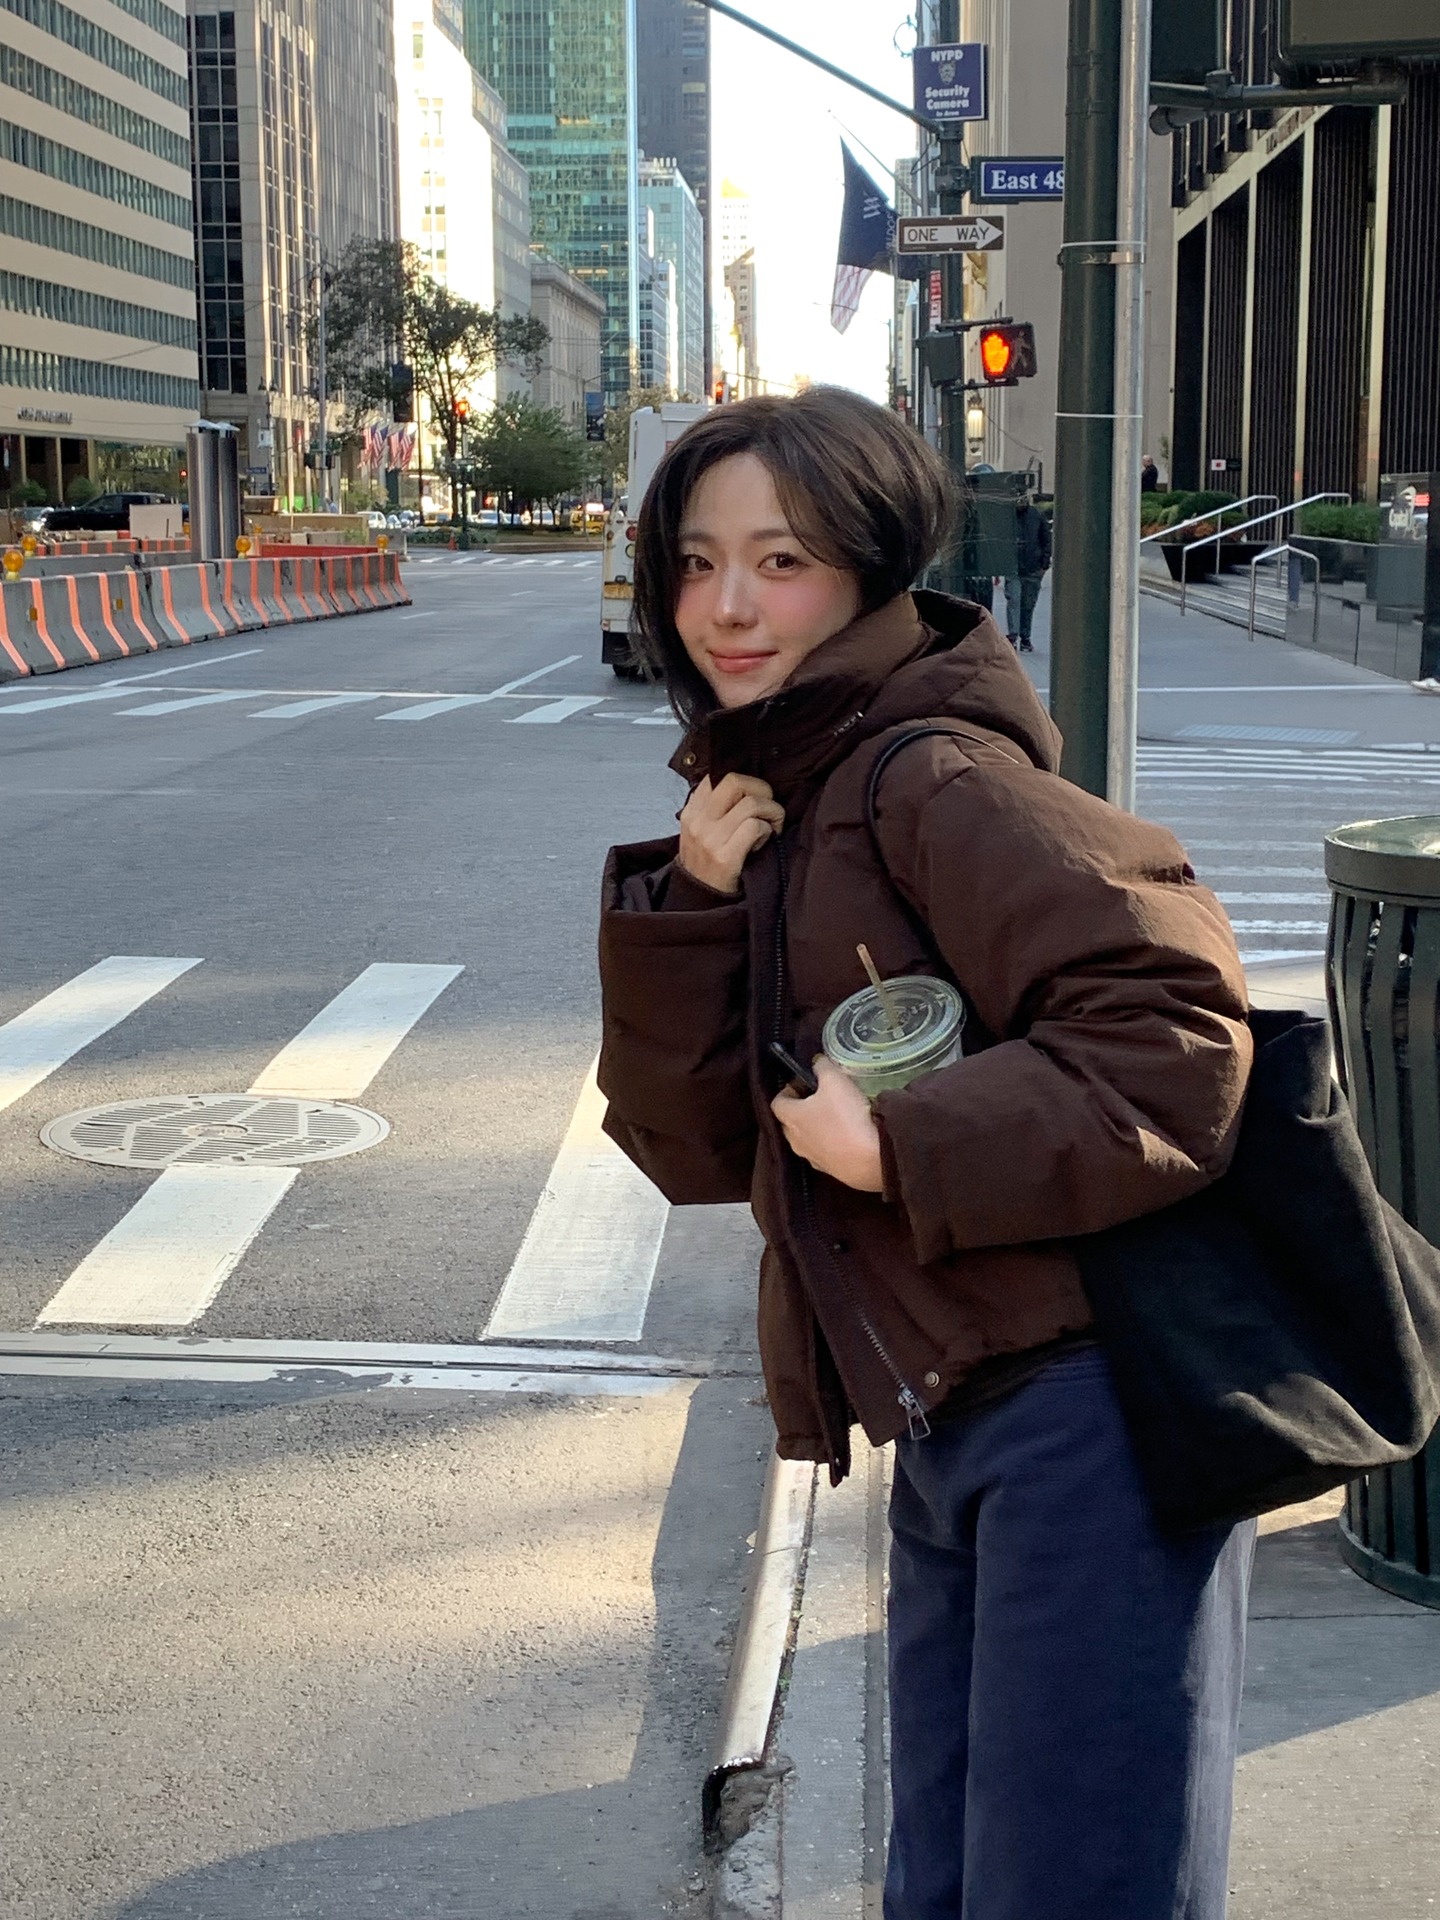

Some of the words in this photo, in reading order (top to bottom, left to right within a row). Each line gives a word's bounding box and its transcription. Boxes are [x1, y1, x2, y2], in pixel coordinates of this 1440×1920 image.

[930, 49, 964, 62] NYPD
[925, 85, 970, 98] Security
[926, 99, 970, 110] Camera
[991, 170, 1038, 190] East
[1043, 171, 1065, 189] 48
[907, 228, 938, 242] ONE
[956, 227, 990, 241] WAY
